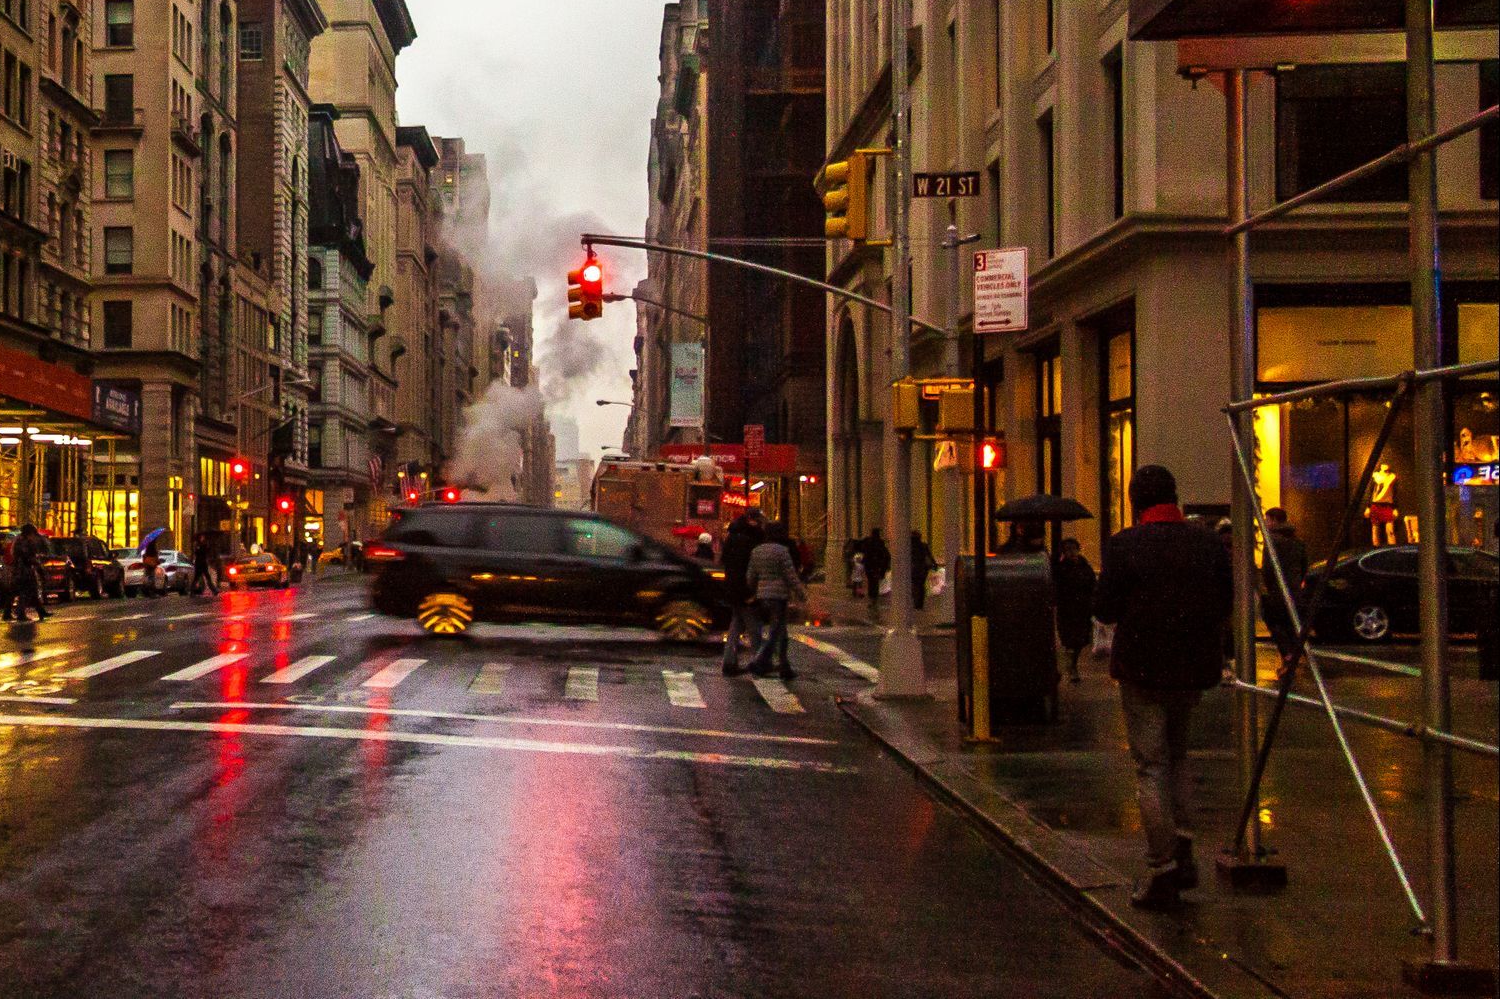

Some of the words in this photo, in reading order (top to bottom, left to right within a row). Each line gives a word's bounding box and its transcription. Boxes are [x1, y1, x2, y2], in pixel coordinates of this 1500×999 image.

[917, 177, 929, 195] W
[936, 177, 951, 195] 21
[958, 176, 974, 195] ST
[976, 254, 984, 270] 3
[976, 273, 1014, 282] COMMERCIAL
[668, 454, 690, 462] new
